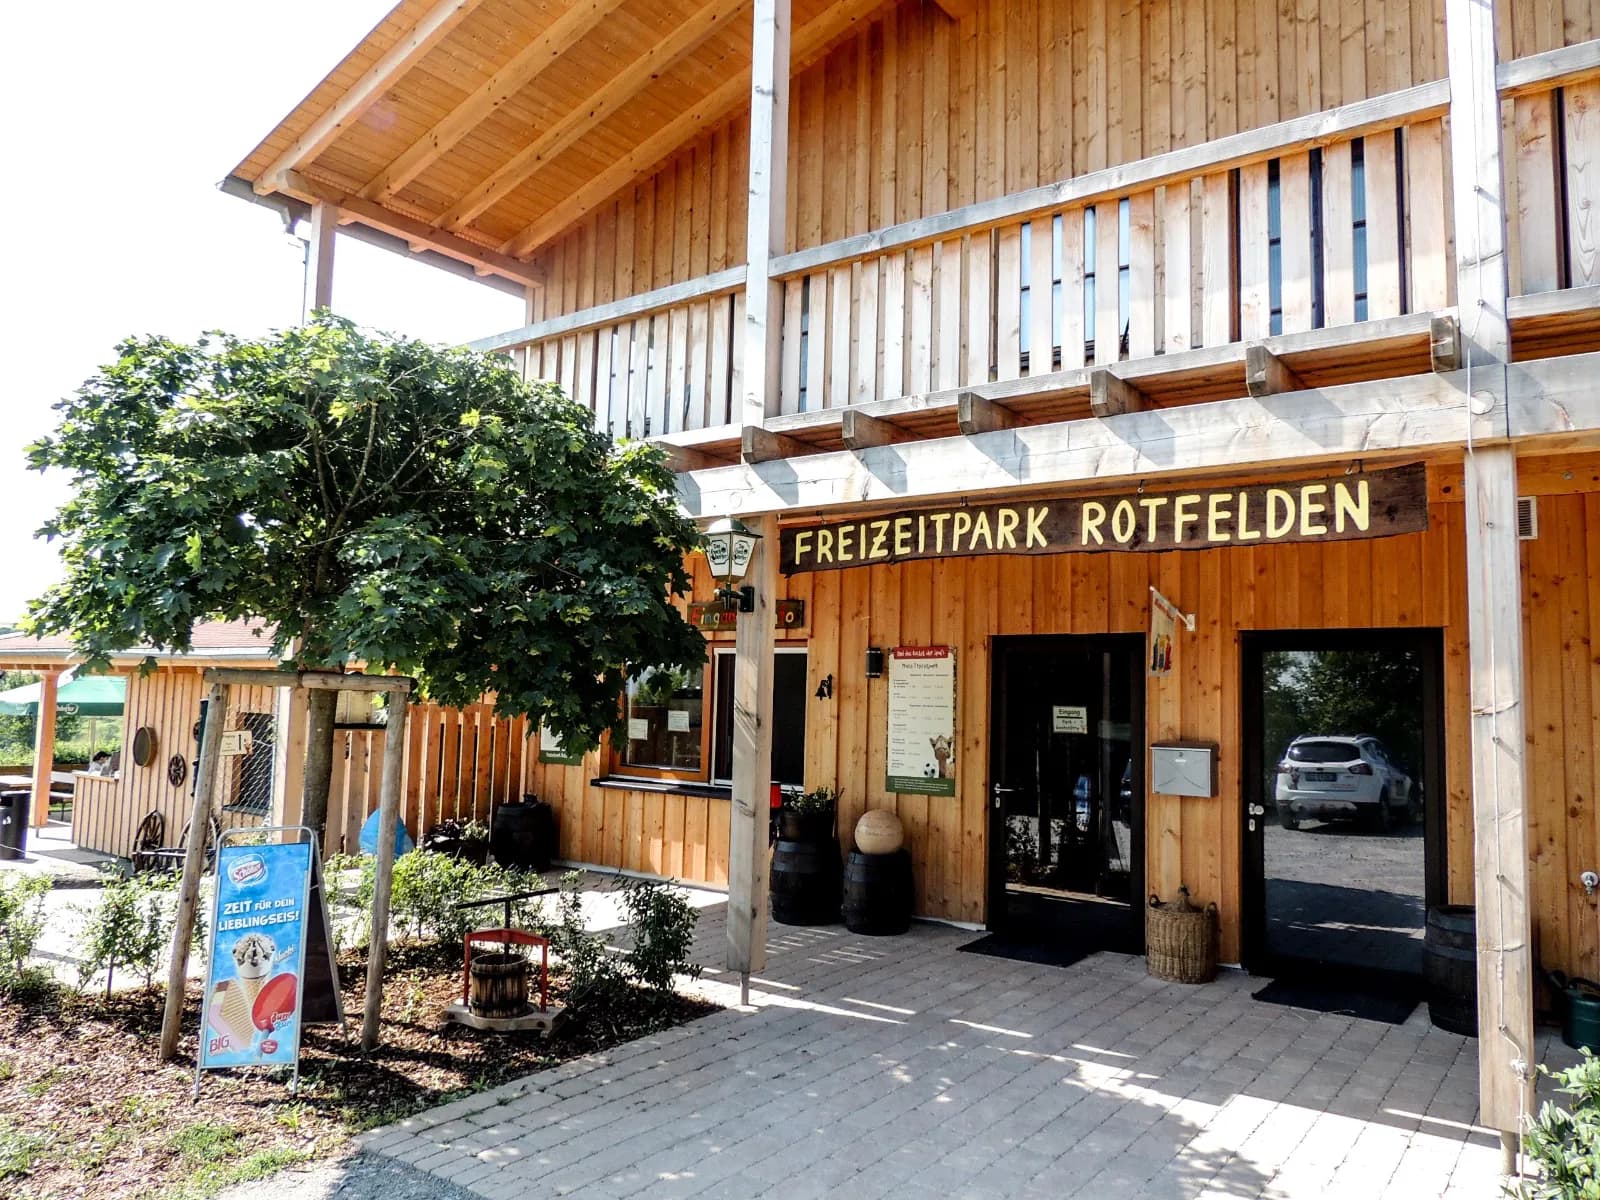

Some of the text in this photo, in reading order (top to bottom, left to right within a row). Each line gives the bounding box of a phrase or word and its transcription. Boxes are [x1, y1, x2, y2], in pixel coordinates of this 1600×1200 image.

[794, 480, 1371, 565] FREIZEITPARK ROTFELDEN
[691, 606, 737, 629] Eingan
[1058, 708, 1081, 717] Eingang
[223, 897, 295, 916] ZEIT FÜR DEIN
[218, 910, 300, 931] LIEBLINGSEIS!
[210, 1036, 230, 1053] BIG
